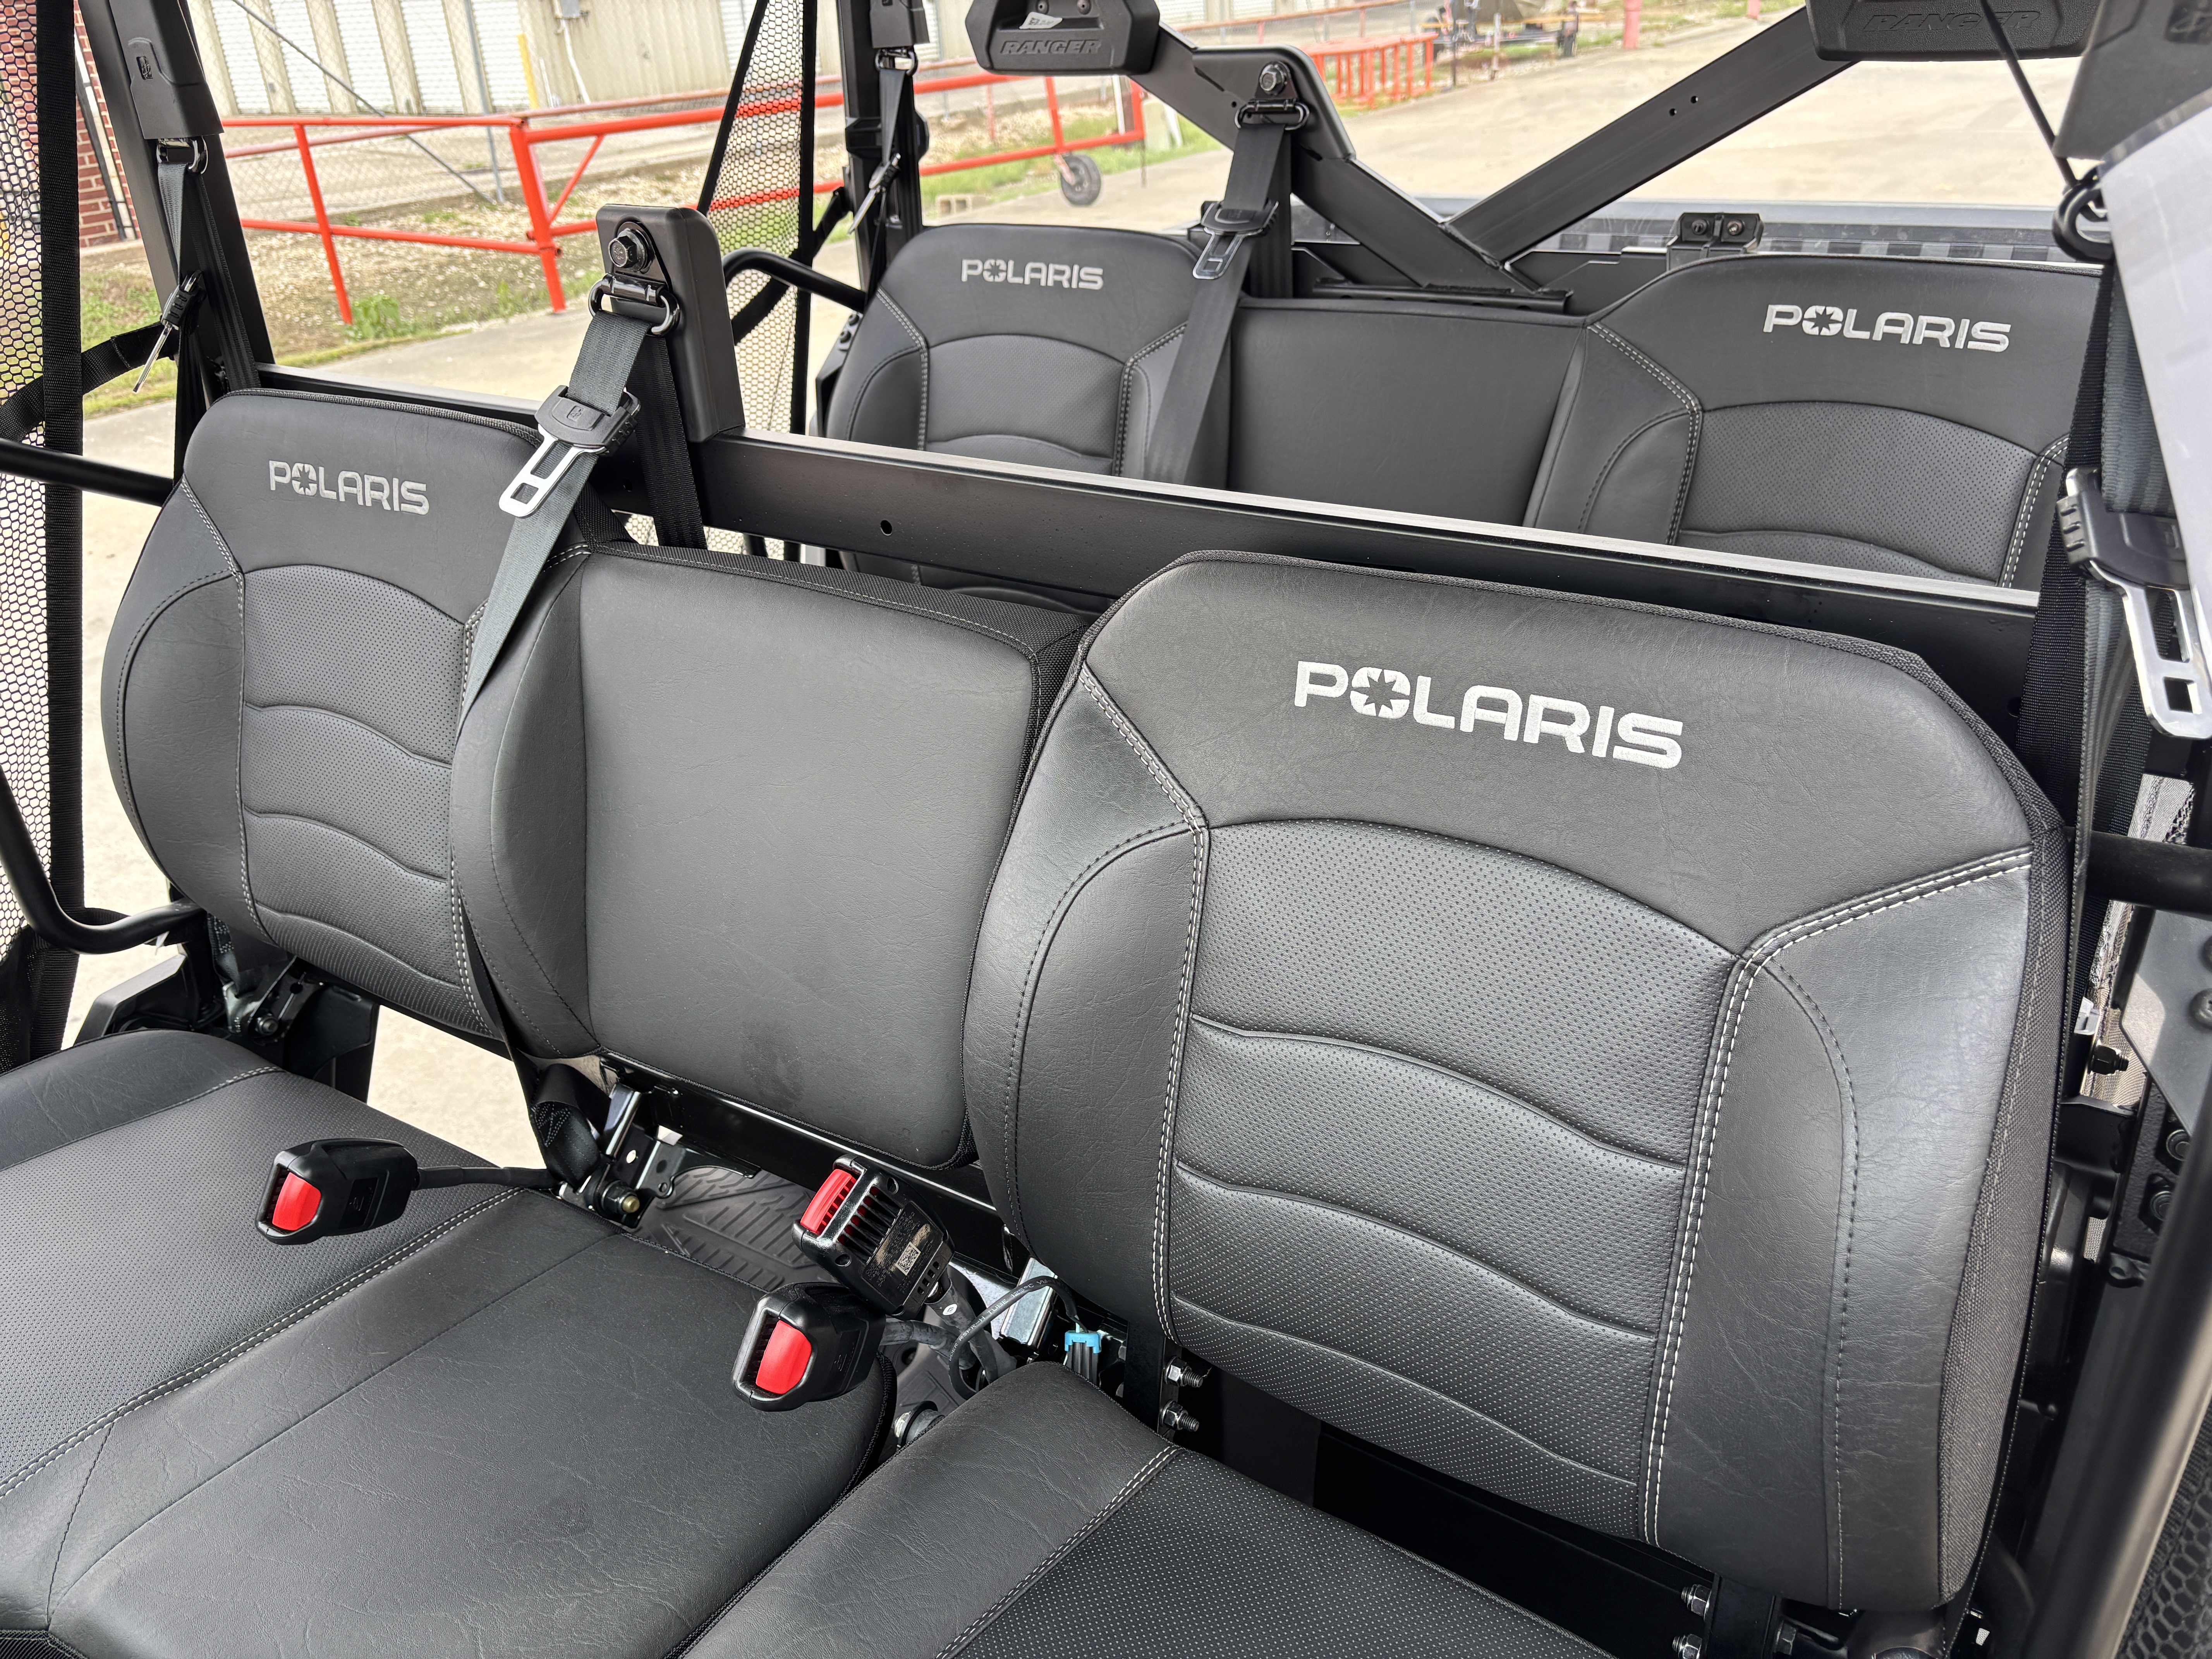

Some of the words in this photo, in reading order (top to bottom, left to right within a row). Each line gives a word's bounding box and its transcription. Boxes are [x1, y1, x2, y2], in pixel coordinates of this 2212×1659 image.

[1000, 39, 1102, 55] RANGER
[962, 259, 1103, 290] POLARIS
[1763, 304, 2011, 352] POLARIS
[268, 460, 429, 515] POLARIS
[1294, 661, 1683, 769] POLARIS
[987, 1298, 1009, 1315] TUBE
